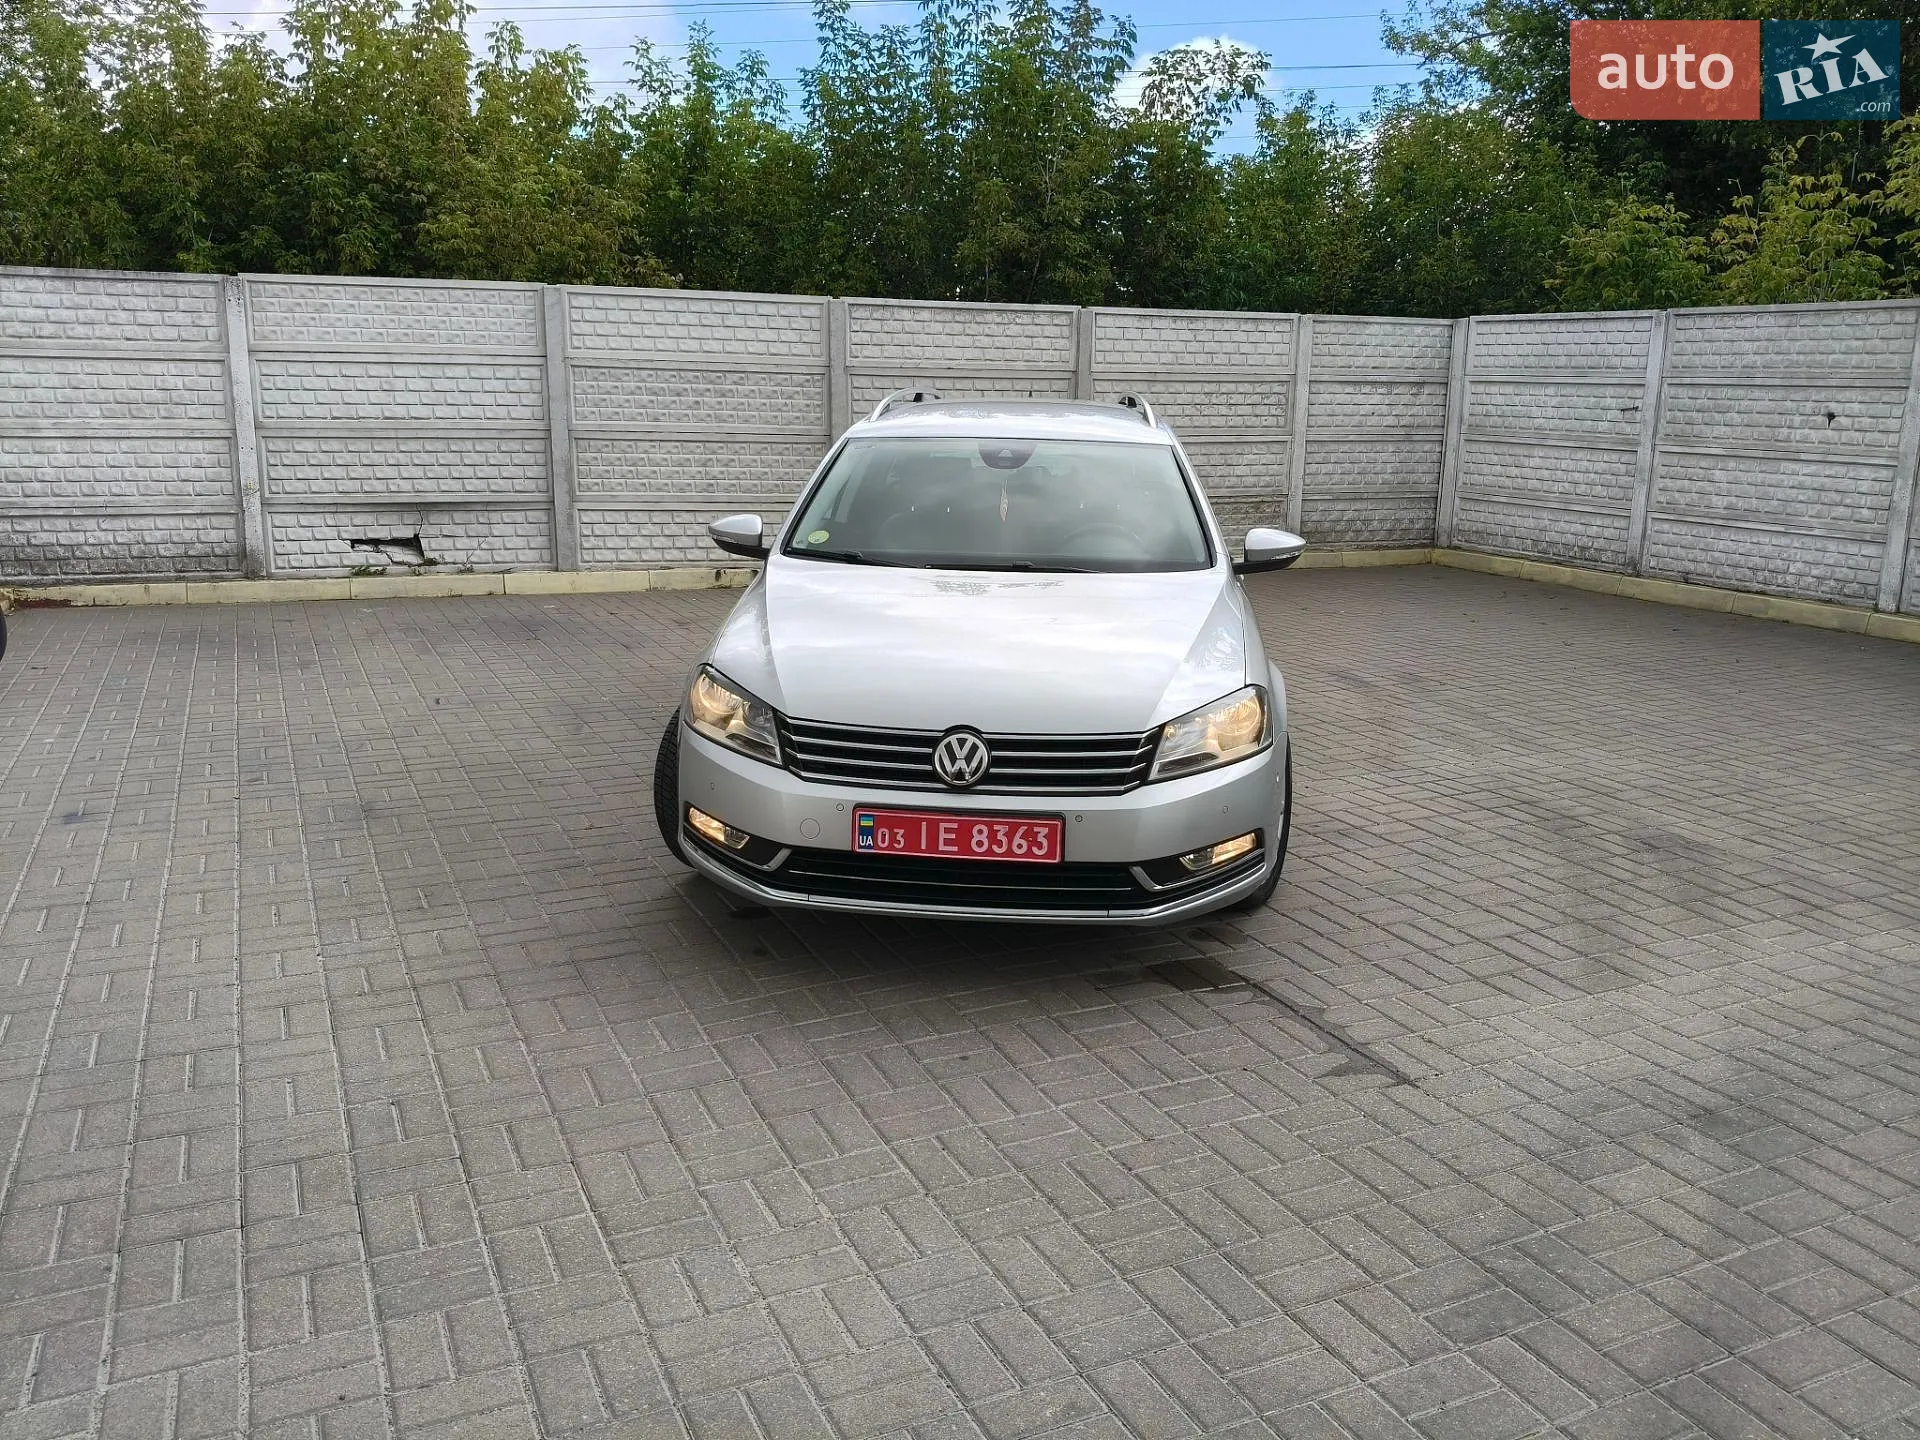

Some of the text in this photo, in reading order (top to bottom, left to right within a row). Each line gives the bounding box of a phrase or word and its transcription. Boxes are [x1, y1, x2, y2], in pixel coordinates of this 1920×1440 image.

[935, 733, 988, 784] VW
[859, 835, 874, 847] UA
[877, 821, 1049, 856] 03 IE 8363
